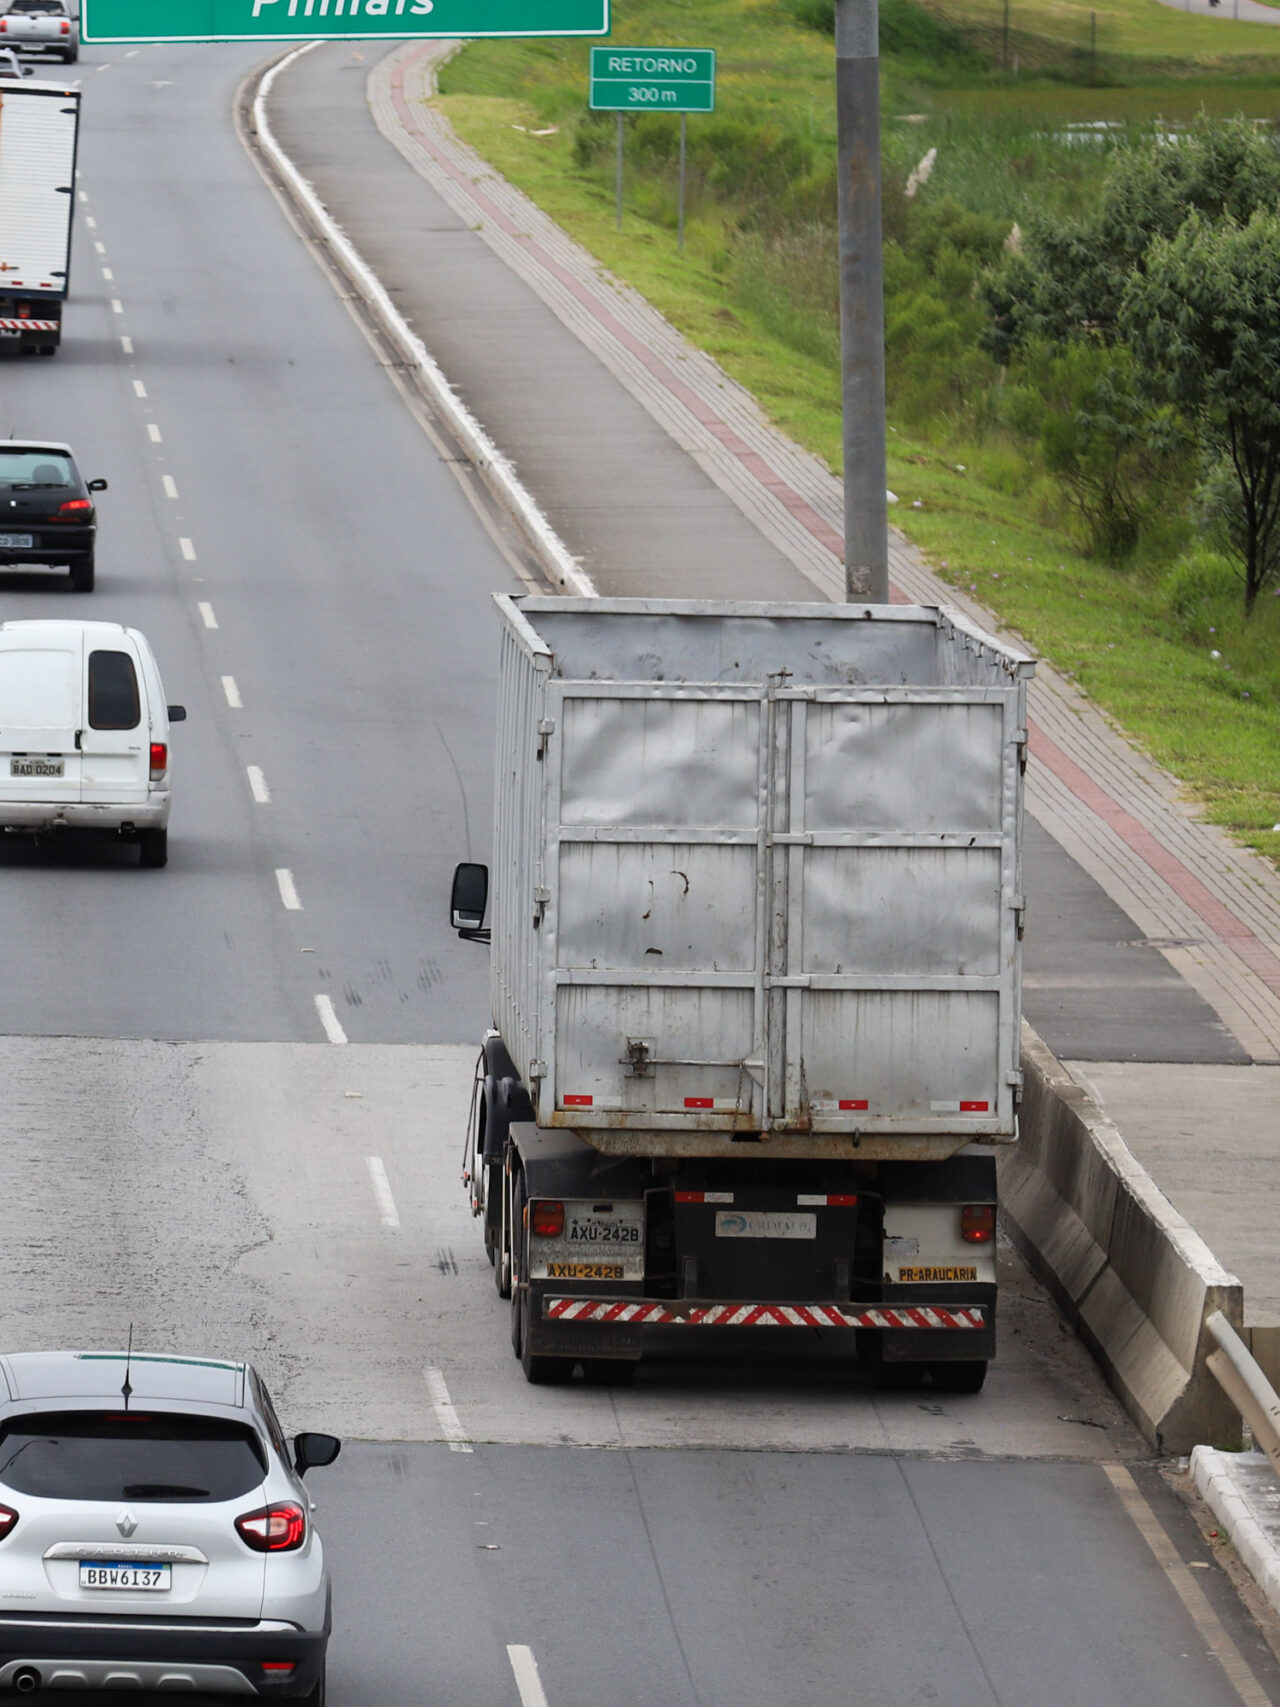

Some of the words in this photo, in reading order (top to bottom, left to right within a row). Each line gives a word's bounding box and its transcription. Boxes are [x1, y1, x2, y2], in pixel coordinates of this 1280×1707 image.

[608, 57, 697, 73] RETORNO
[628, 87, 659, 102] 300
[661, 90, 677, 102] m
[87, 1569, 162, 1586] BBW6I37
